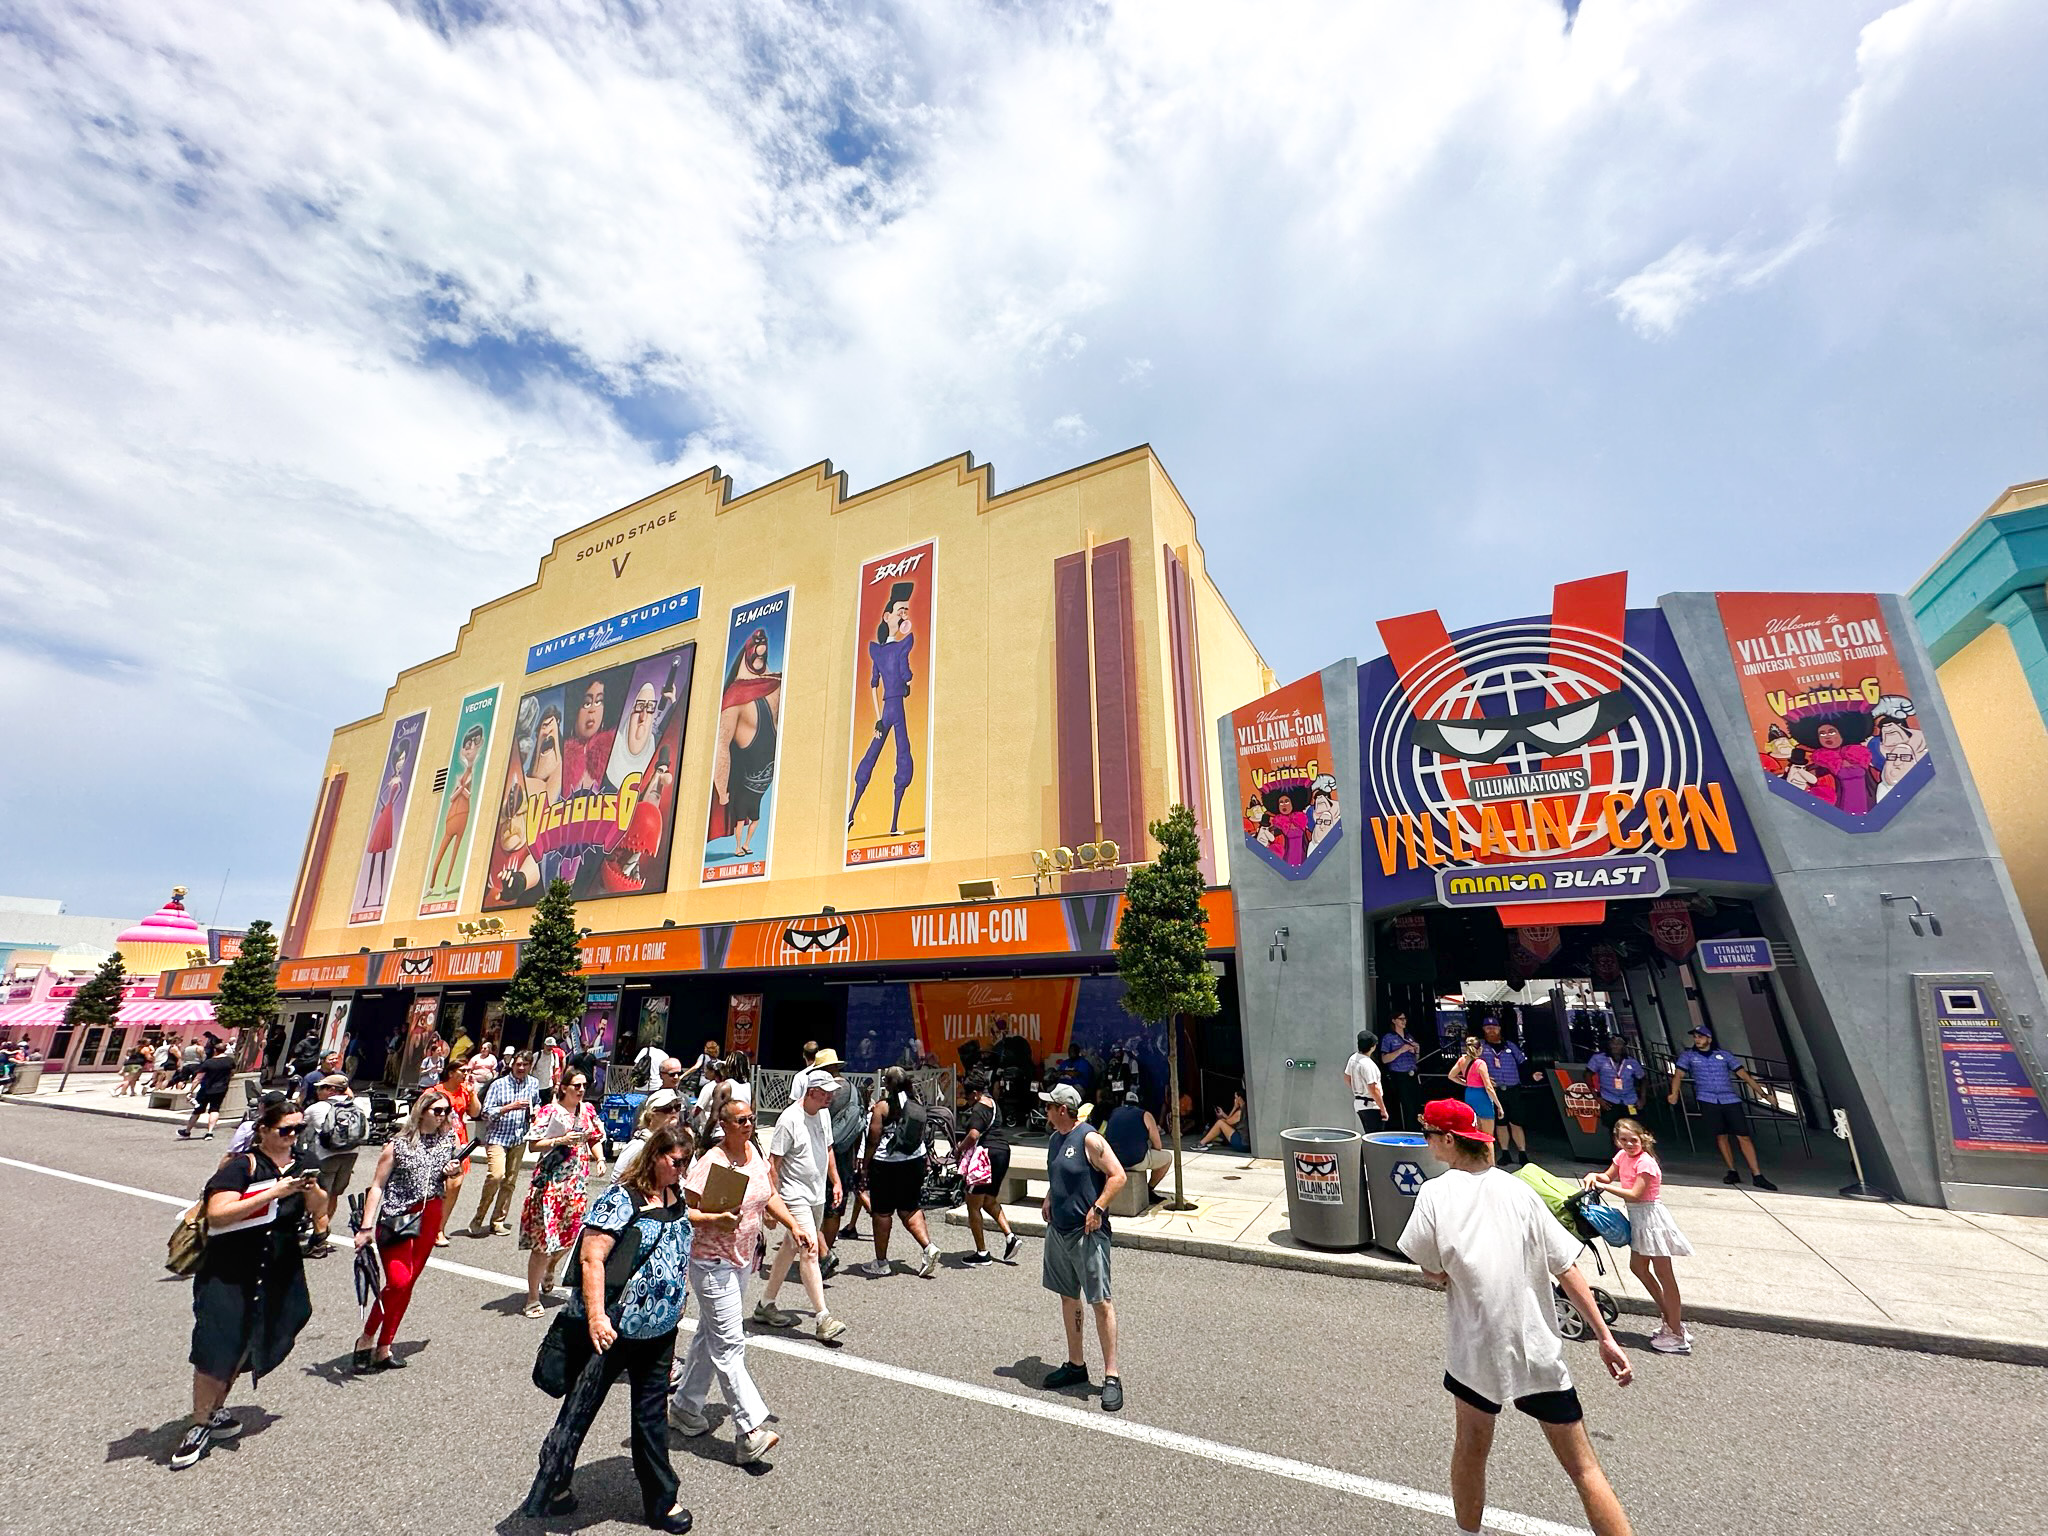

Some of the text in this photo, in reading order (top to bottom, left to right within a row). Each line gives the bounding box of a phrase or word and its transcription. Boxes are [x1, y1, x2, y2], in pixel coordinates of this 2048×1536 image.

[576, 511, 677, 561] SOUND STAGE
[612, 551, 631, 578] V
[869, 553, 926, 586] BRATT
[747, 600, 784, 624] MACHO
[1766, 613, 1840, 635] Welcome to
[536, 596, 689, 657] UNIVERSAL STUDIOS
[1736, 618, 1883, 663] VILLAIN-CON
[1742, 643, 1888, 676] UNIVERSAL STUDIOS FLORIDA
[1796, 671, 1840, 684] FEATURING
[465, 698, 493, 714] VECTOR
[1256, 708, 1301, 724] Welcome to
[1238, 713, 1324, 746] VILLAIN-CON
[1239, 733, 1326, 756] UNIVERSAL STUDIOS FLORIDA
[1270, 754, 1297, 764] FEATURING
[1475, 771, 1585, 799] ILLUMINATION'S
[1370, 782, 1738, 877] VILLAIN-CON
[866, 844, 903, 859] VILLAIN-CON
[719, 864, 749, 877] VILLAIN-CON
[1450, 865, 1648, 895] minion BLAST
[911, 908, 1027, 947] VILLAIN-CON
[596, 946, 612, 966] FUN,
[616, 944, 631, 963] IT'S
[633, 944, 639, 962] A
[642, 942, 667, 961] CRIME
[1713, 945, 1757, 955] ATTRACTION
[1719, 953, 1756, 963] ENTRANCE
[448, 950, 503, 976] VILLAIN-CON
[1299, 1180, 1341, 1195] VILLAIN-CON
